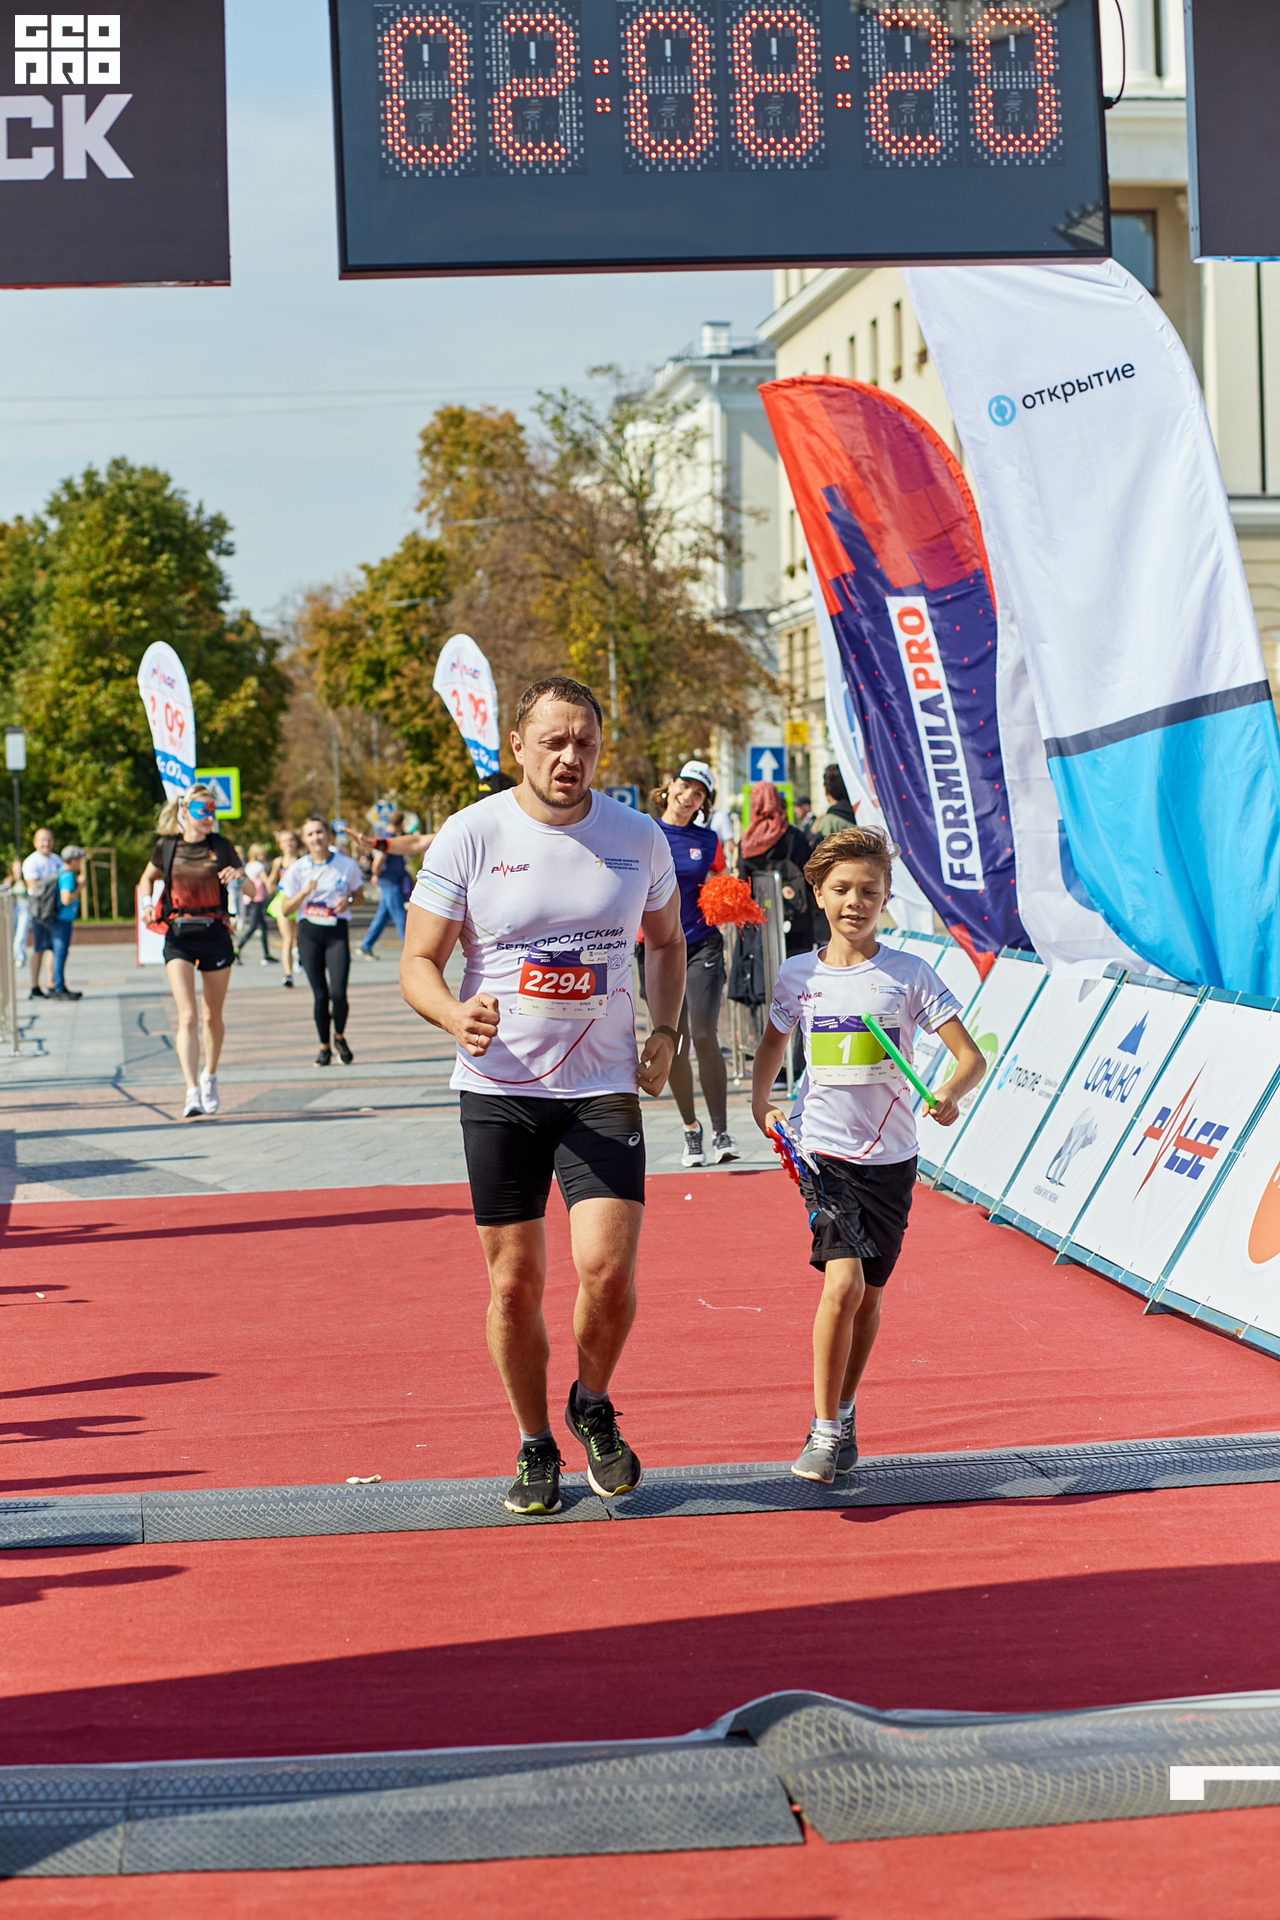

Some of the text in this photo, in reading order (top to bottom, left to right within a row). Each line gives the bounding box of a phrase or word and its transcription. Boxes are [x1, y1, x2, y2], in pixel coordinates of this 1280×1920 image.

[382, 8, 1057, 164] 02:08:20
[1022, 363, 1135, 409] открытие
[524, 970, 591, 994] 2294
[837, 1034, 852, 1064] 1
